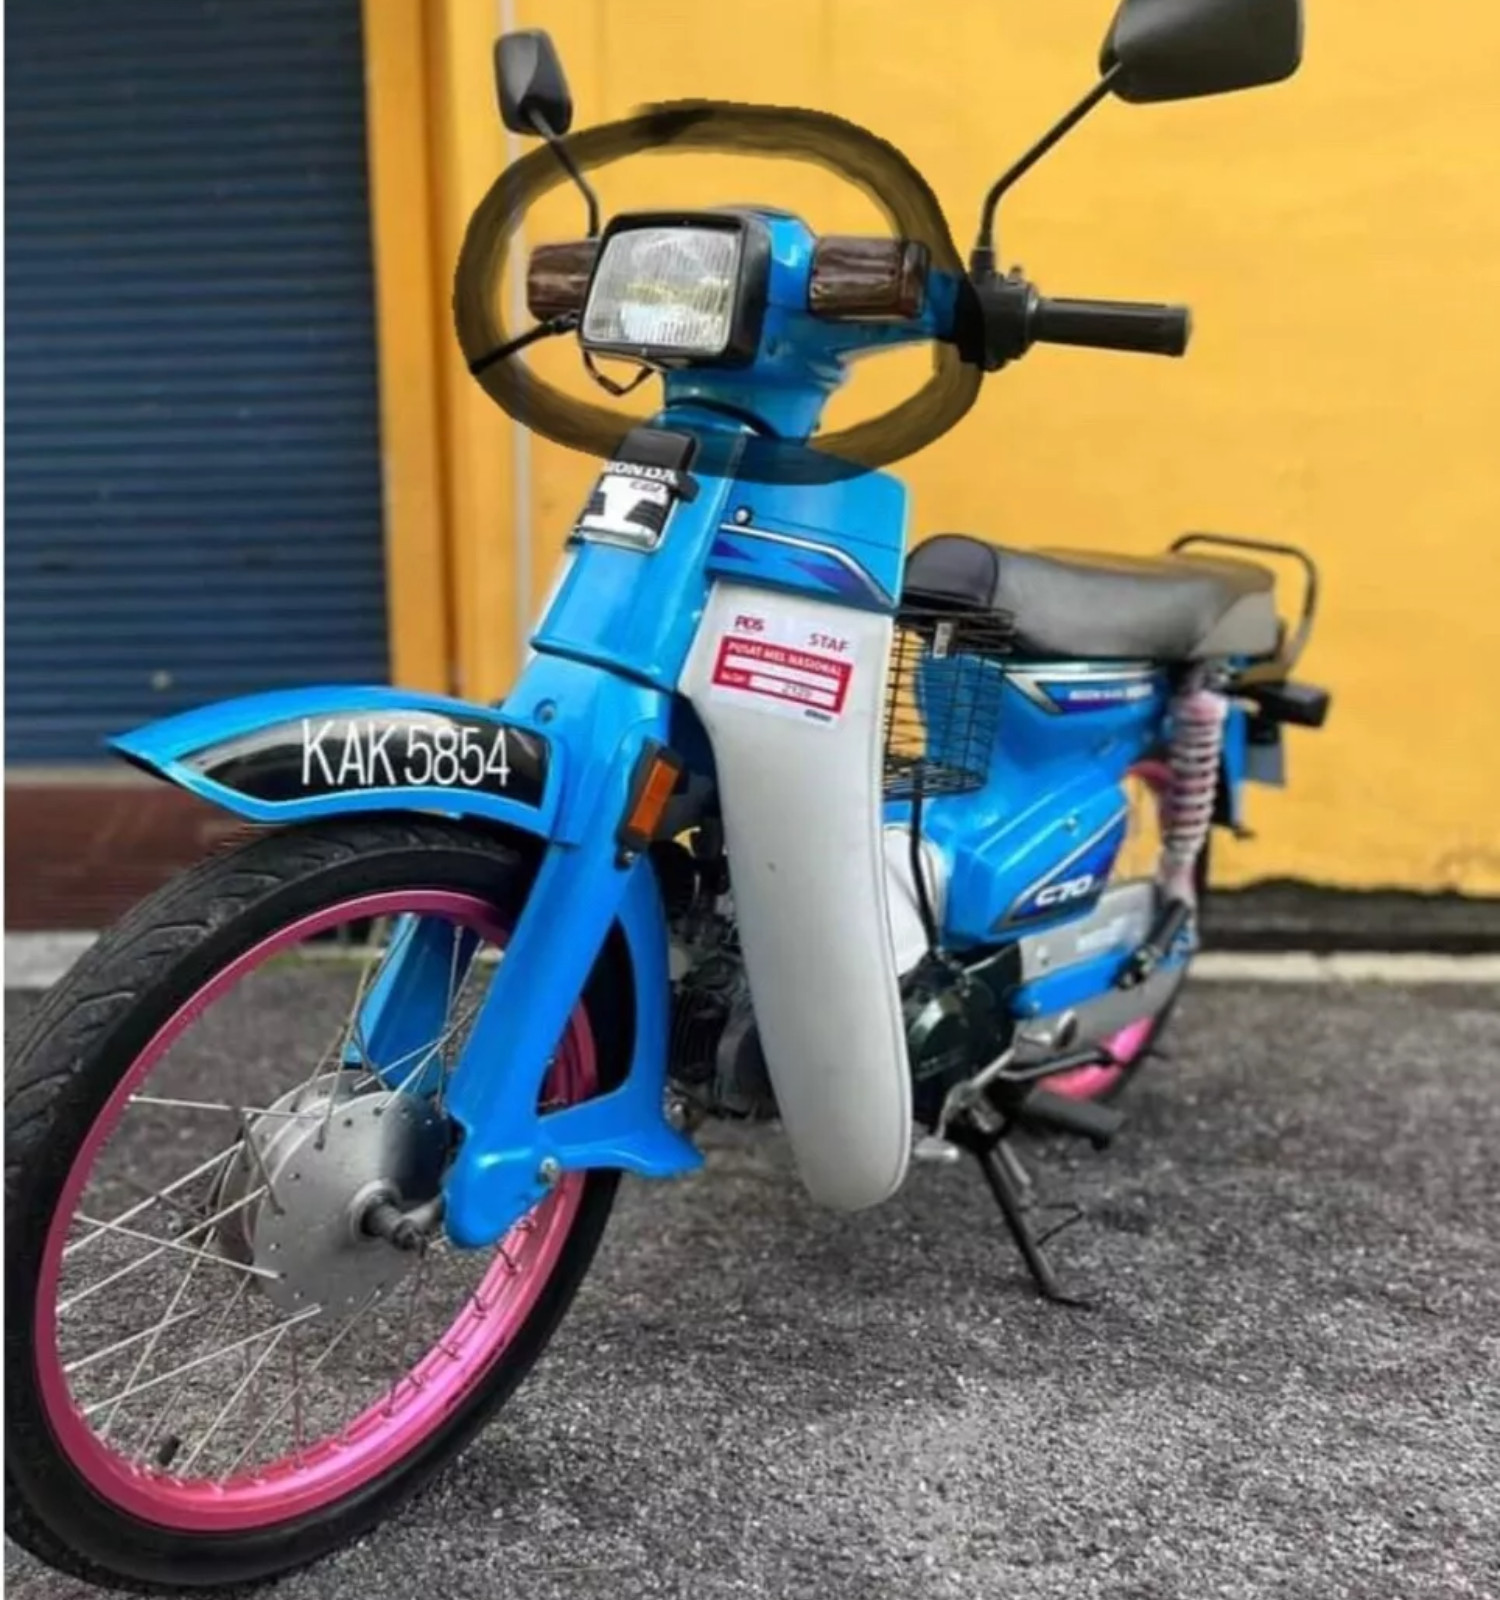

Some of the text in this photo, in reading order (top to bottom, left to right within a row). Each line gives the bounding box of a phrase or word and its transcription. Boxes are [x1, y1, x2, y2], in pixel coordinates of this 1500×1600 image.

[734, 615, 764, 631] POS
[808, 632, 849, 652] STAF
[302, 718, 512, 787] KAK 5854
[1035, 874, 1094, 907] C70
